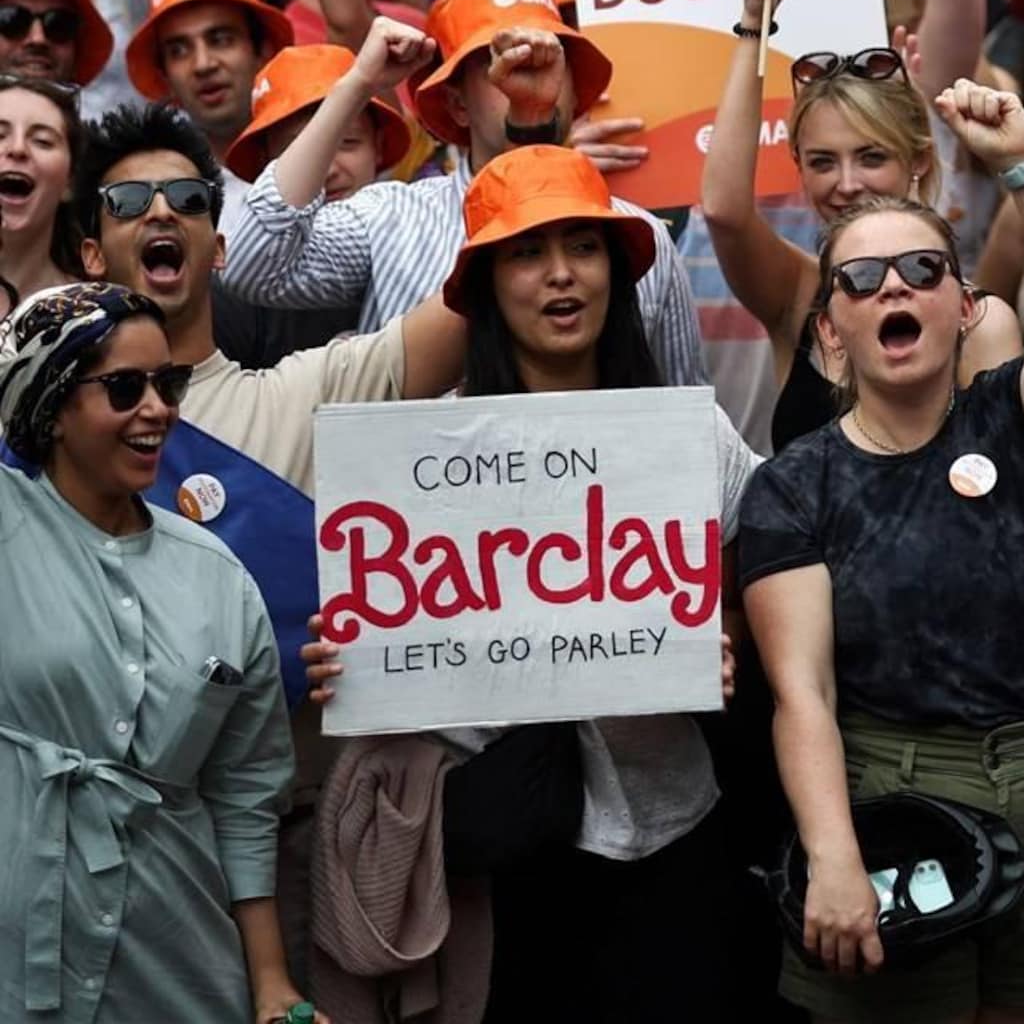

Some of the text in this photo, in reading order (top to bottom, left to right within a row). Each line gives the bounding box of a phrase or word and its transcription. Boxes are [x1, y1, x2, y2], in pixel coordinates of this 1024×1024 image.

[414, 447, 598, 491] COME ON
[319, 484, 721, 645] Barclay
[384, 626, 667, 674] LET'S GO PARLEY
